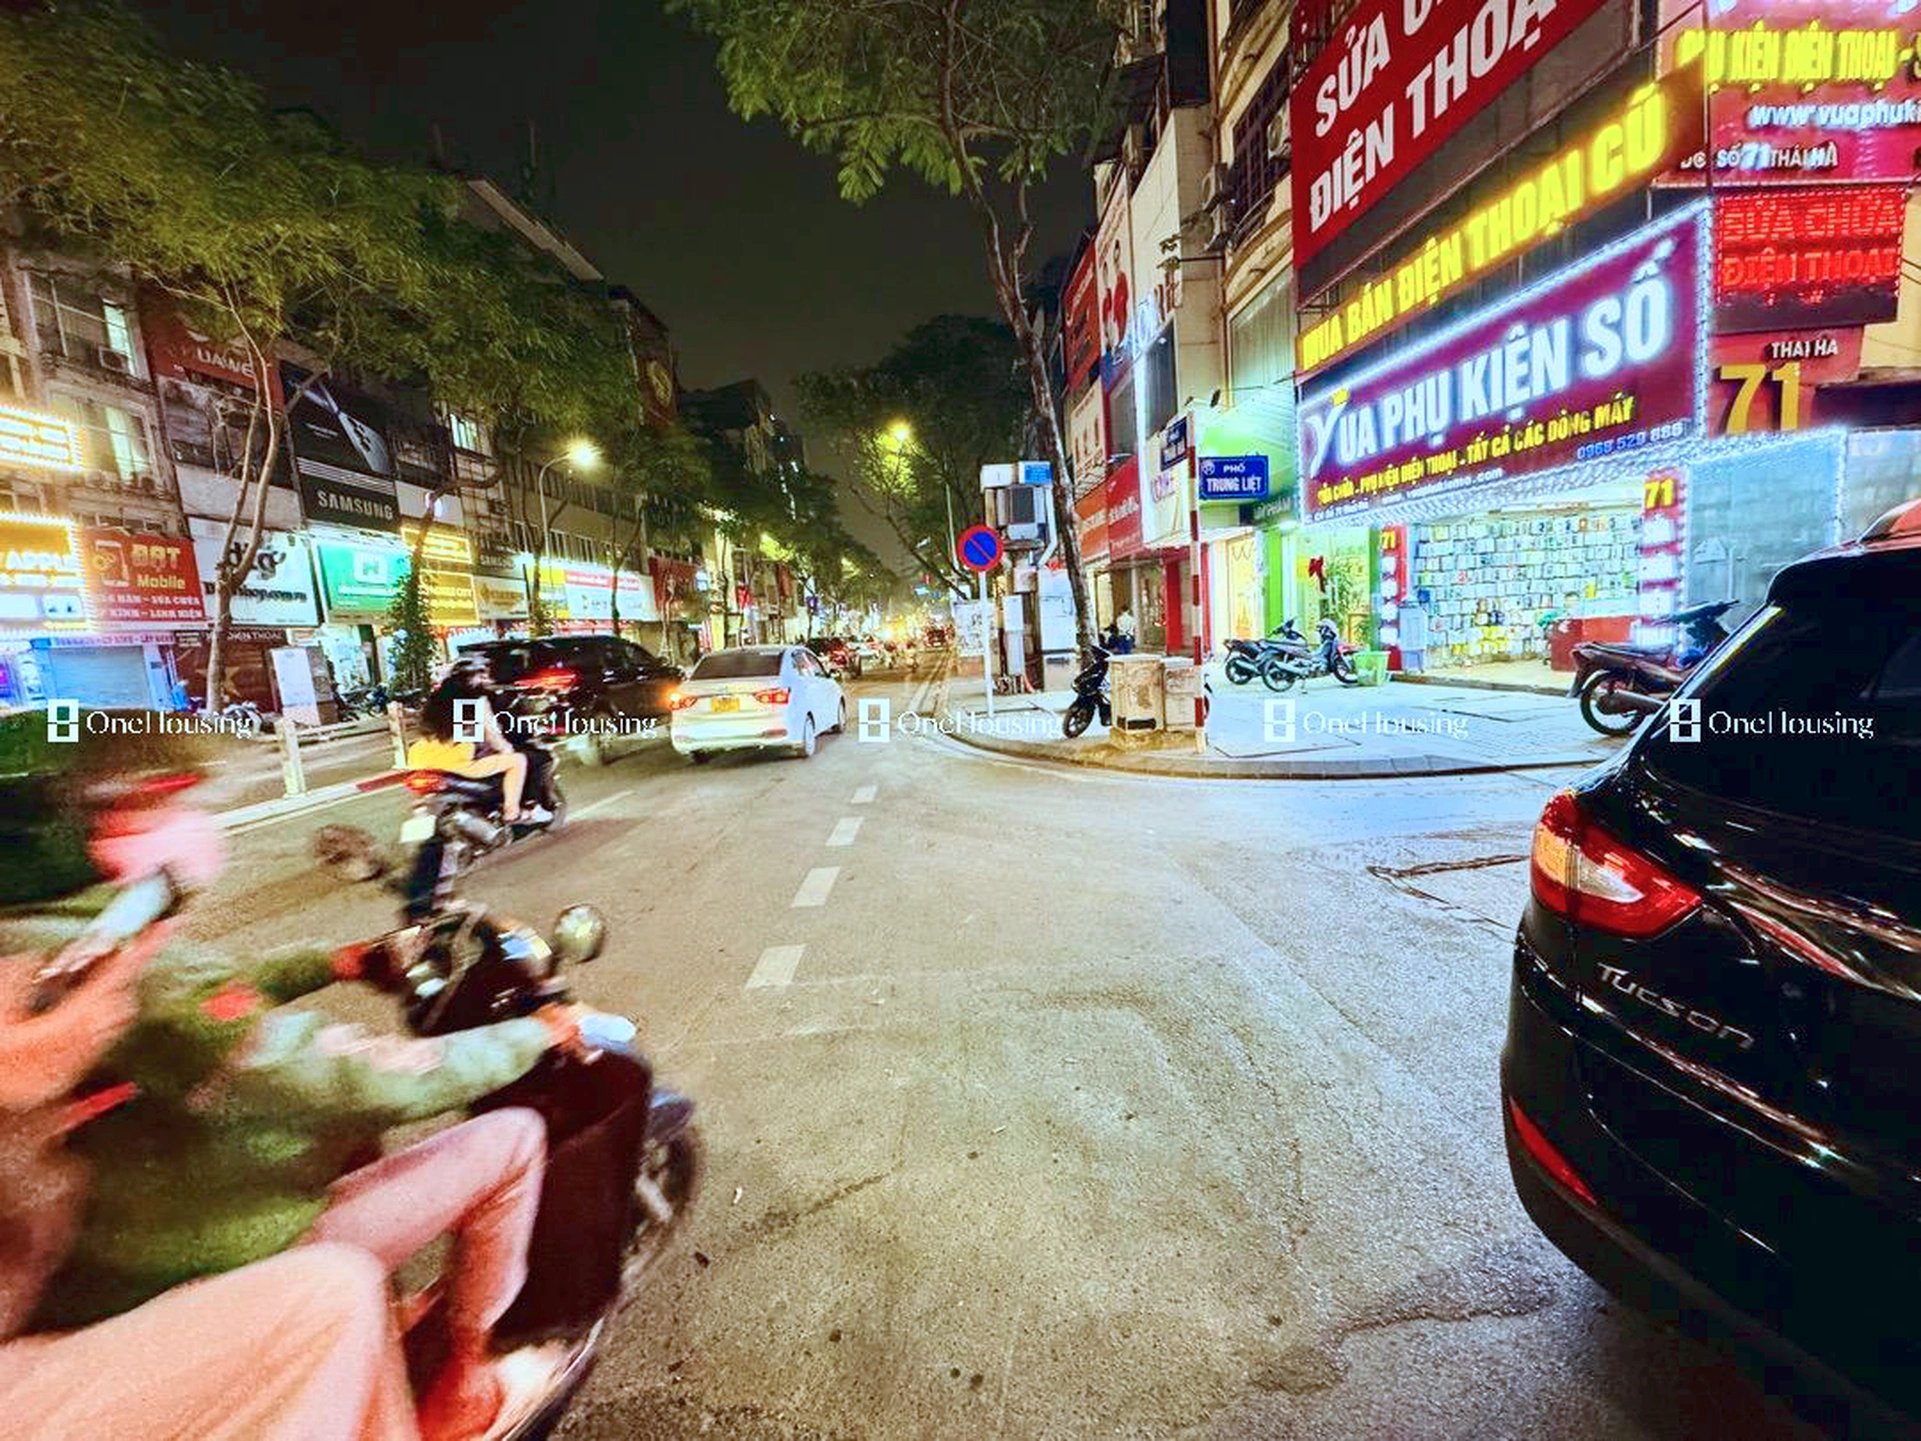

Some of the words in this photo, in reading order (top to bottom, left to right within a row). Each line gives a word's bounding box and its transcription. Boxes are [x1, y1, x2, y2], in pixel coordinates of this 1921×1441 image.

[1315, 11, 1391, 138] SỬA
[1310, 102, 1394, 233] ĐIỆN
[1301, 315, 1342, 371] MUA
[1346, 281, 1393, 344] BÁN
[1397, 236, 1463, 305] ĐIỆN
[1466, 149, 1584, 271] THOẠI
[1589, 82, 1666, 193] CŨ
[1383, 371, 1449, 447] PHỤ
[1460, 317, 1571, 420] KIỆN
[1582, 238, 1677, 377] SỐ
[1721, 363, 1800, 434] 71
[1467, 432, 1489, 464] TẤT
[1513, 420, 1544, 451] CÁC
[1548, 409, 1591, 442] DÒNG
[1594, 392, 1635, 429] MÁY
[1206, 476, 1239, 493] TRUNG
[1241, 475, 1262, 493] LIỆT
[1223, 462, 1245, 473] PHỐ
[317, 489, 394, 521] SAMSUNG
[1645, 478, 1674, 509] 71
[1382, 529, 1397, 549] 71
[137, 574, 186, 590] Mobile
